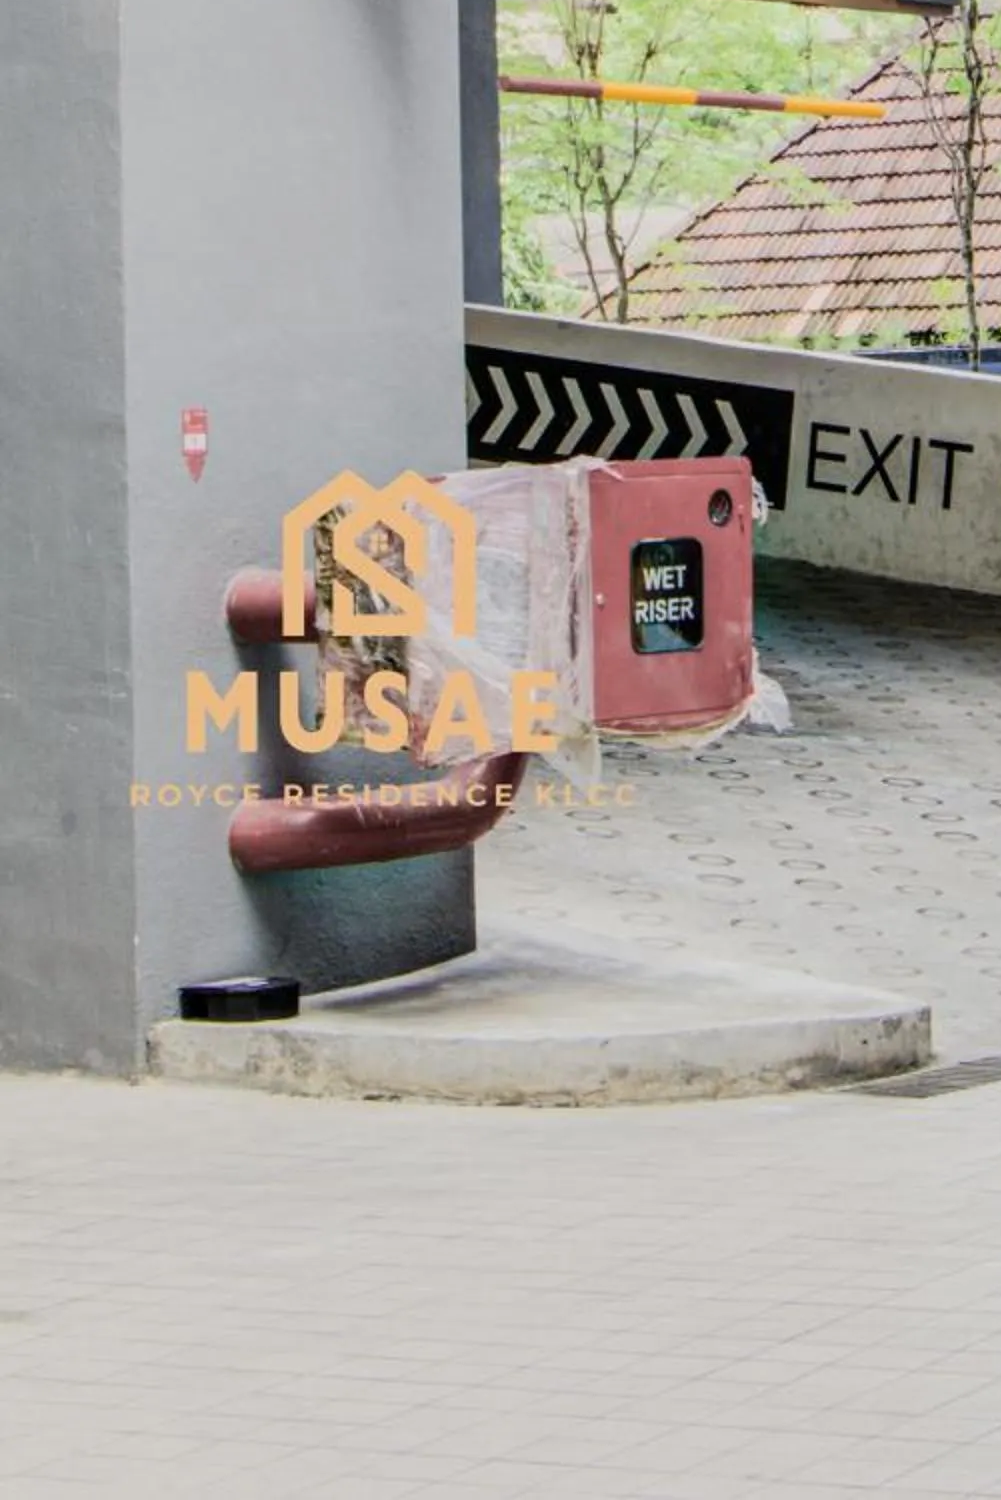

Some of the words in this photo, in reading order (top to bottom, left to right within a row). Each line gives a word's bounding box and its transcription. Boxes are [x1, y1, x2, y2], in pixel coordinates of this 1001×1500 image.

[805, 421, 974, 509] EXIT
[642, 564, 687, 591] WET
[635, 597, 695, 624] RISER
